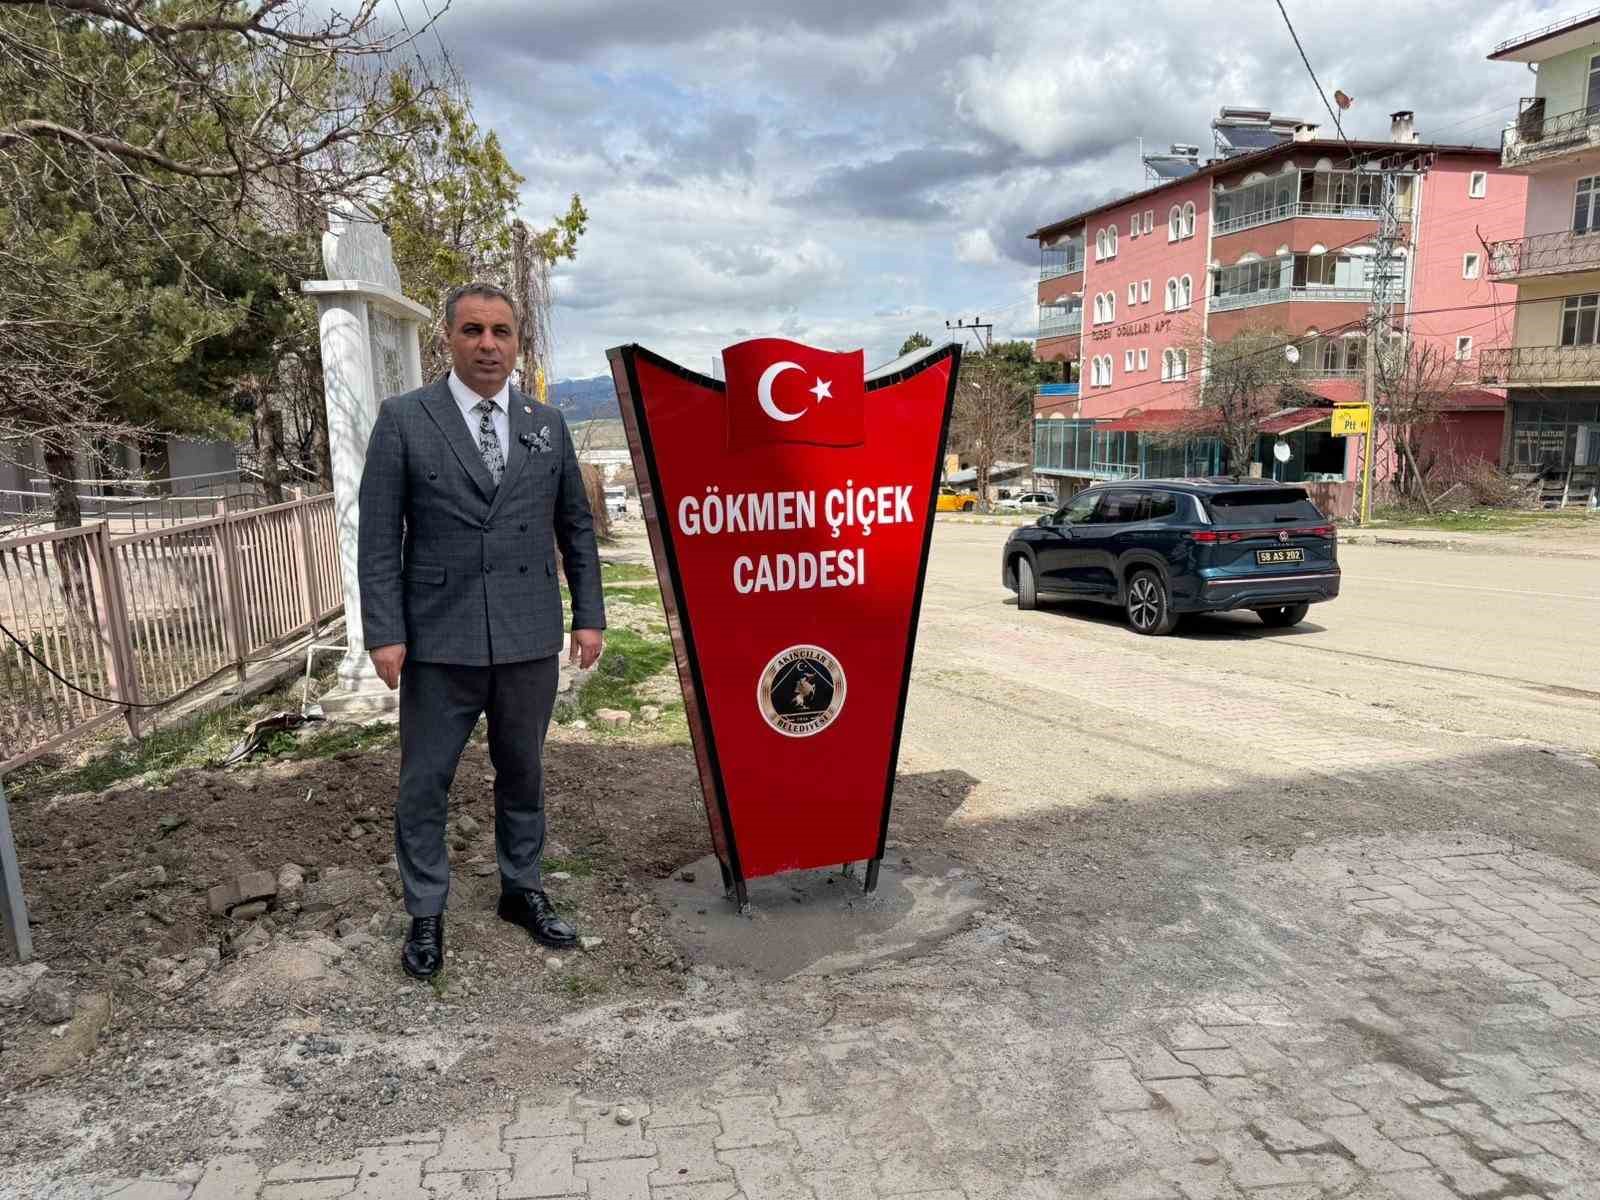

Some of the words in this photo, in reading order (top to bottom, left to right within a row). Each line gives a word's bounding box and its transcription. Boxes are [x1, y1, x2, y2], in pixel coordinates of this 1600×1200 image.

[678, 486, 816, 536] GÖKMEN
[824, 479, 914, 538] ÇİÇEK
[733, 548, 865, 594] CADDESI
[1260, 551, 1271, 562] 58
[1273, 551, 1284, 561] AS
[1286, 550, 1300, 560] 202
[777, 650, 827, 666] AKINCILAR
